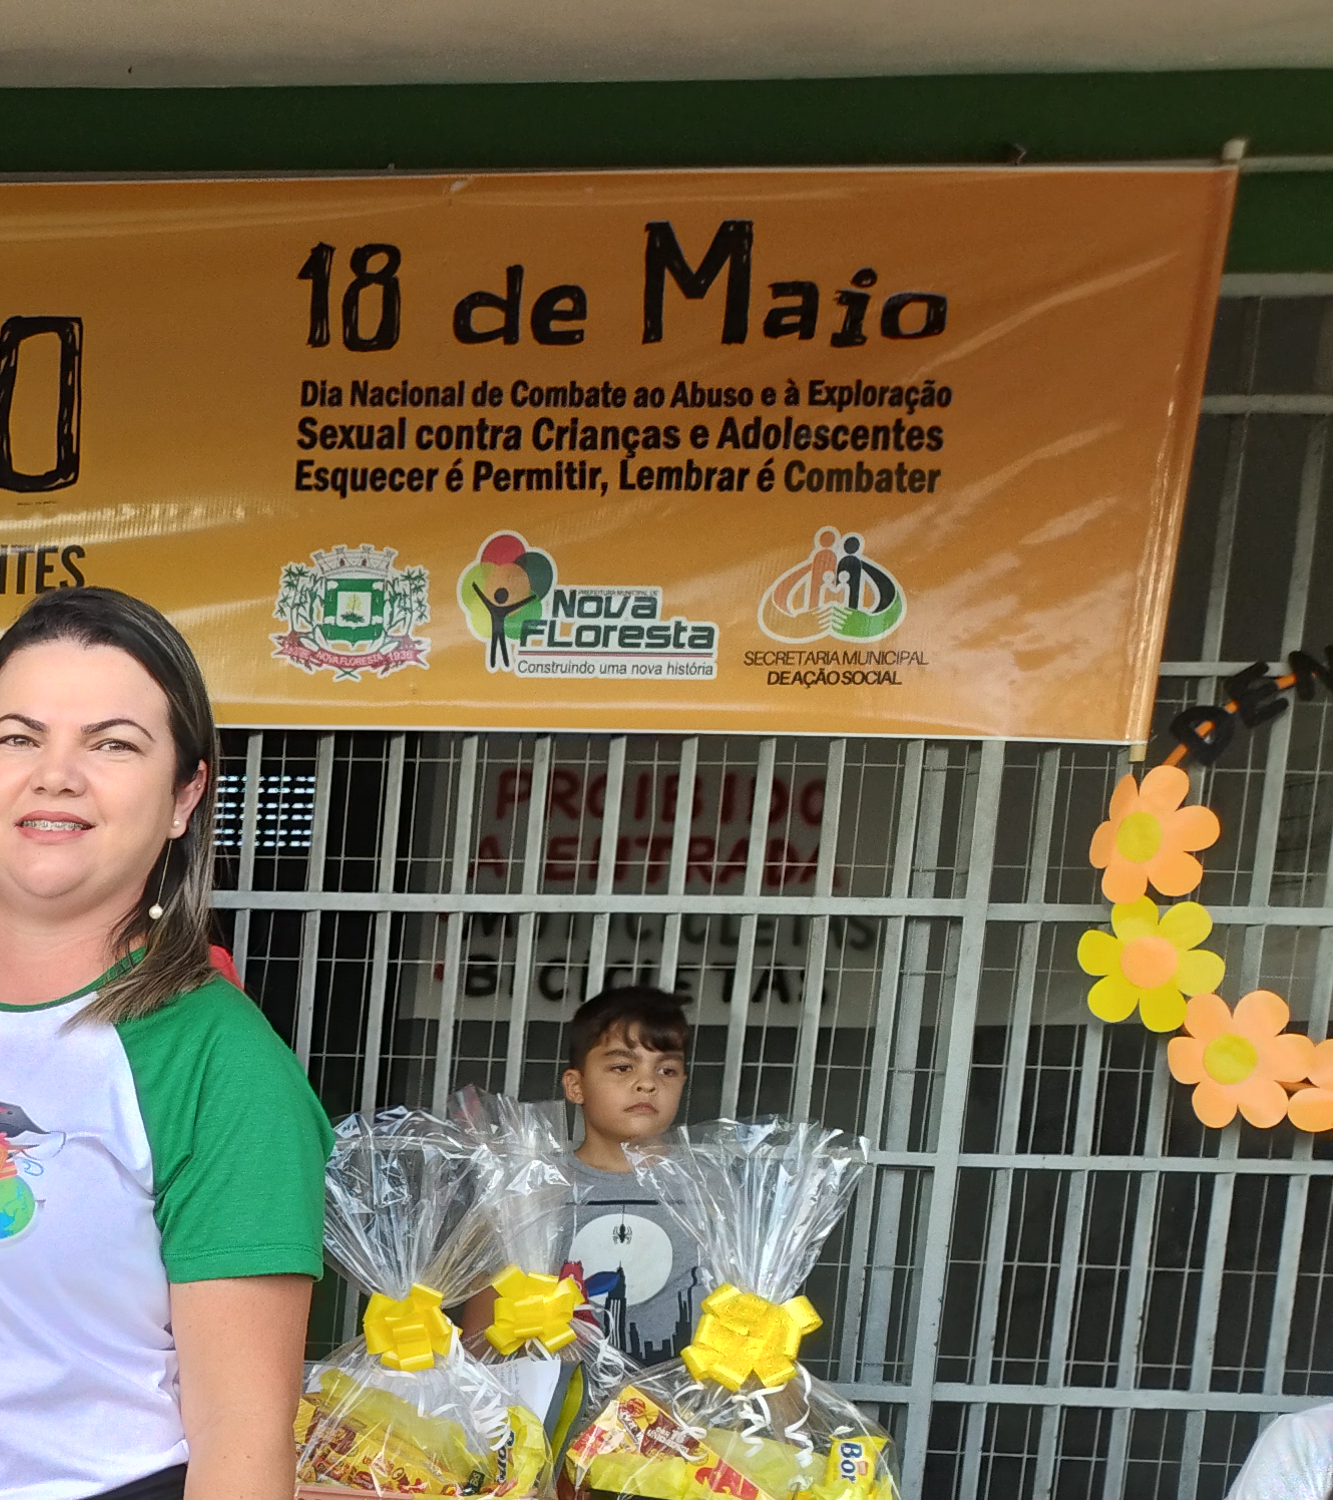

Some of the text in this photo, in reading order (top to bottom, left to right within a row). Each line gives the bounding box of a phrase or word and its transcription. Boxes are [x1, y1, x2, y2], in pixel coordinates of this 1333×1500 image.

[296, 219, 948, 353] 18 de Maio
[300, 379, 953, 416] Dia Nacional de Combate ao Abuso e à Exploração
[296, 415, 945, 459] Sexual contra Crianças e Adolescentes
[294, 457, 943, 499] Esquecer é Permitir, Lembrar é Combater
[517, 659, 715, 676] Construindo uma nova história
[743, 650, 929, 666] SECRETARIA MUNICIPAL
[767, 668, 903, 689] DE AÇÃO SOCIAL
